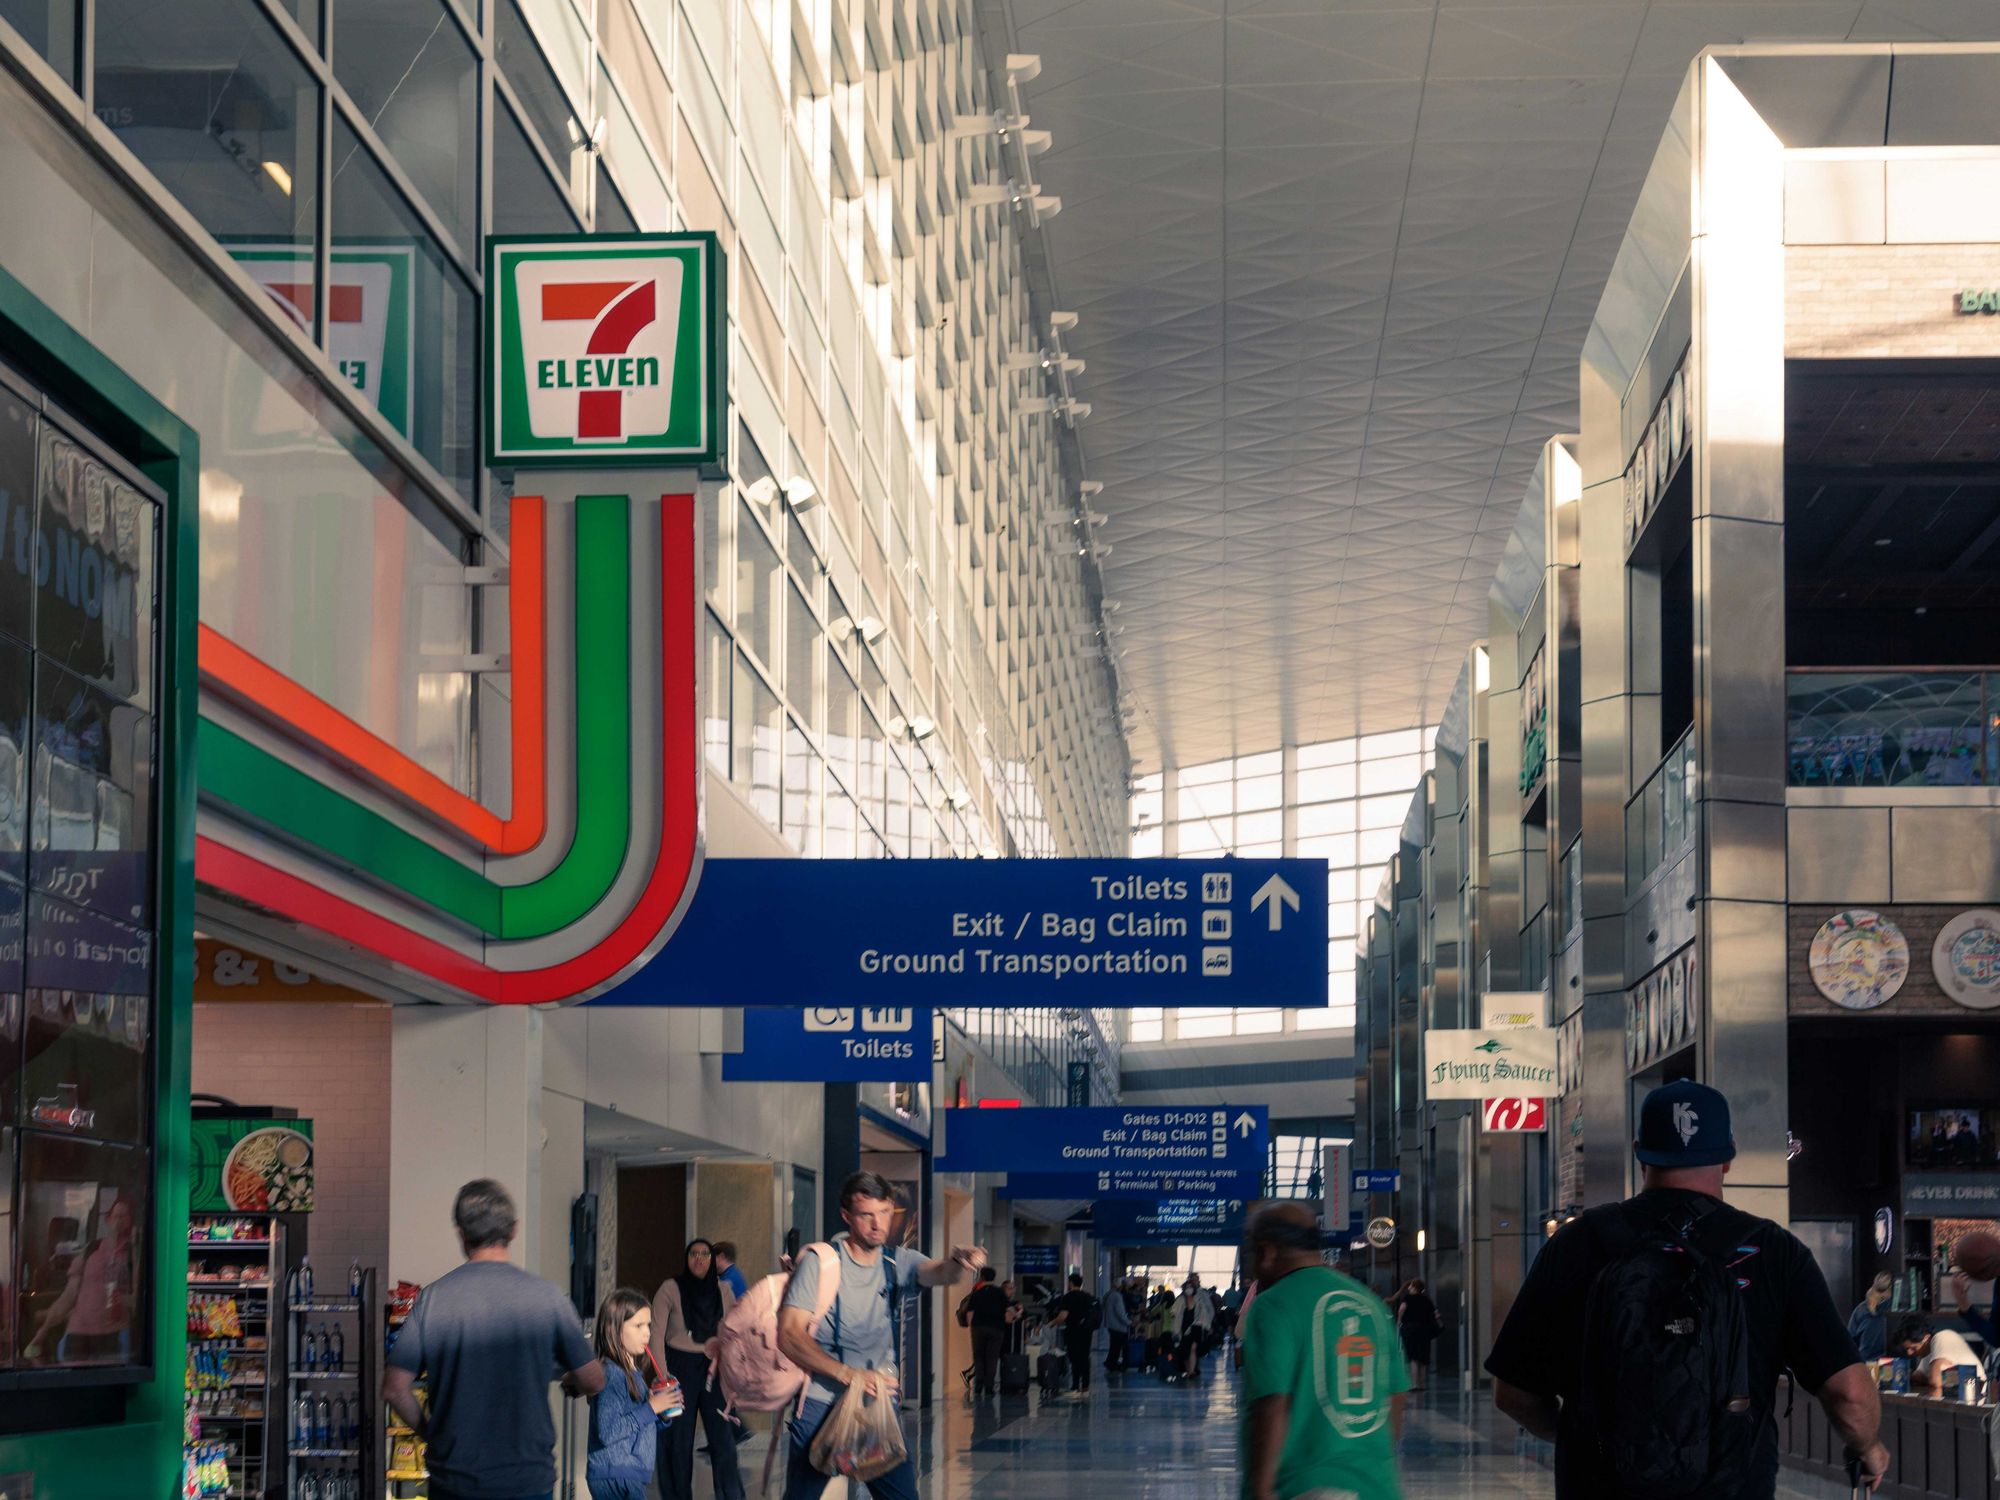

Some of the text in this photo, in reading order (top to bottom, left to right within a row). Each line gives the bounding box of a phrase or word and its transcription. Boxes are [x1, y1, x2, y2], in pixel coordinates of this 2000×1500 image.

[1960, 287, 2000, 313] BA
[541, 279, 656, 438] 7
[1091, 875, 1188, 900] Toilets
[952, 912, 1187, 943] Exit / Bag Claim
[860, 949, 1187, 980] Ground Transportation
[841, 1038, 913, 1059] Toilets
[1431, 1057, 1556, 1085] Flying Saucer
[1123, 1113, 1207, 1125] Gates D1-D12
[1103, 1128, 1207, 1143] Exit / Bag Claim
[1062, 1145, 1207, 1160] Ground Transportation
[1114, 1179, 1158, 1190] Terminal
[1177, 1180, 1216, 1192] Parking
